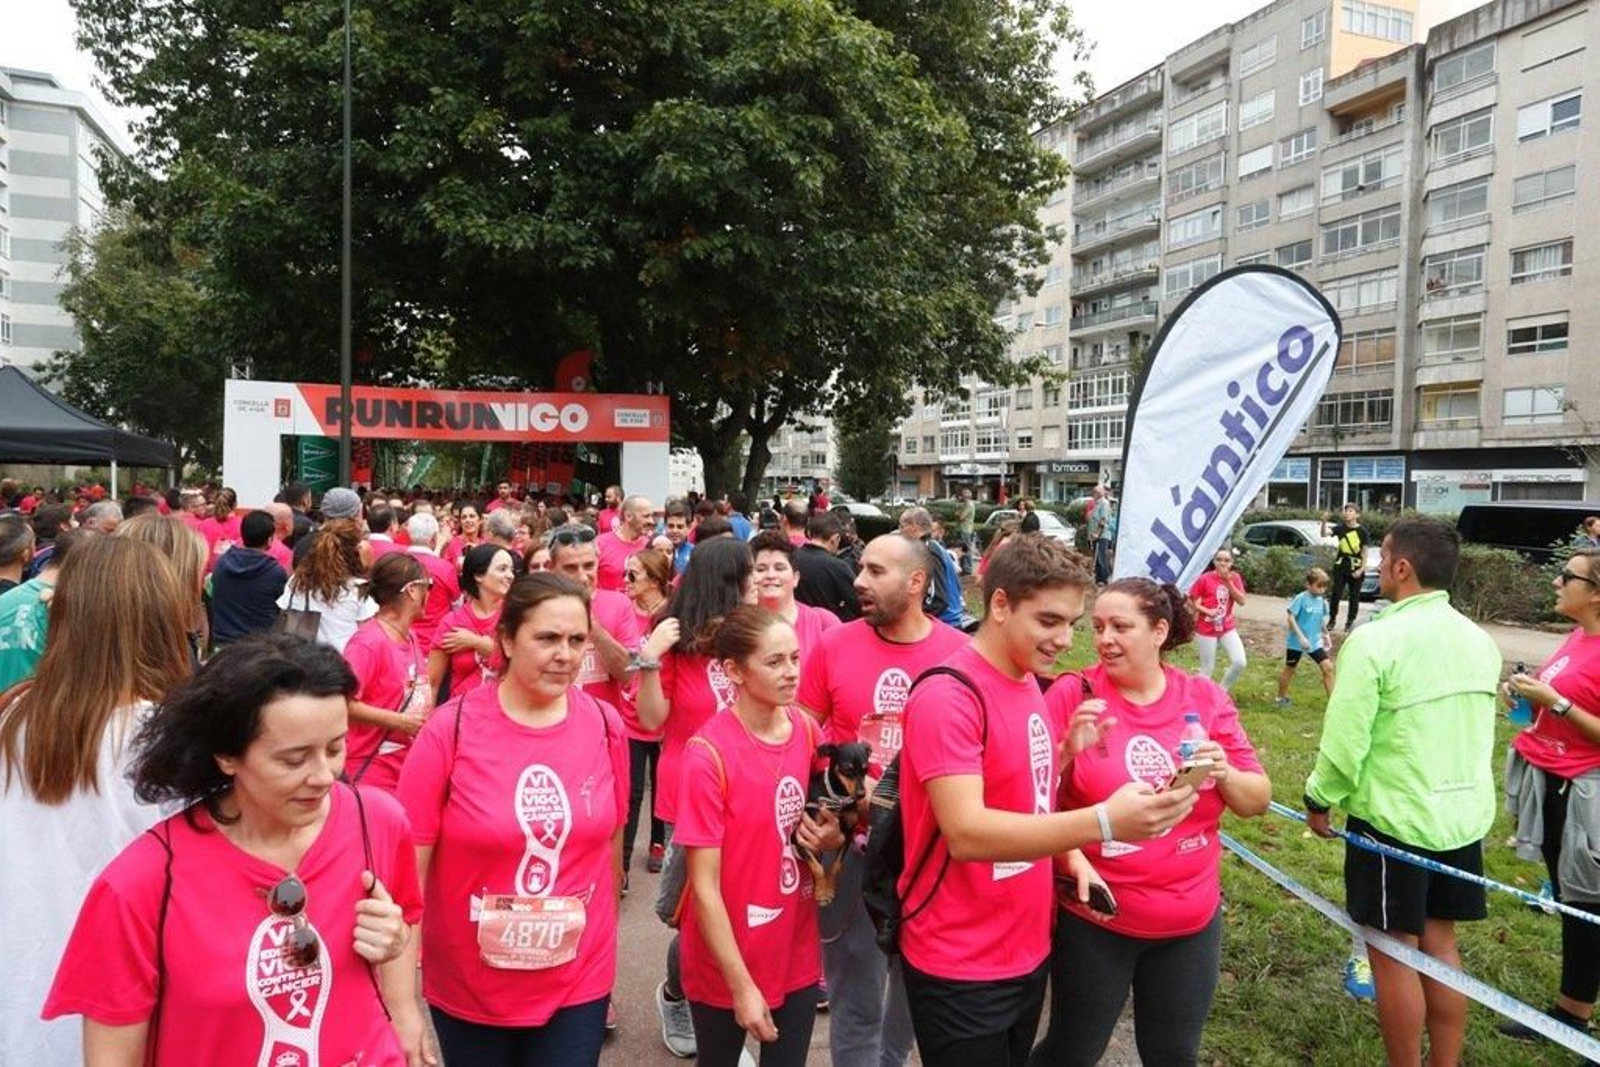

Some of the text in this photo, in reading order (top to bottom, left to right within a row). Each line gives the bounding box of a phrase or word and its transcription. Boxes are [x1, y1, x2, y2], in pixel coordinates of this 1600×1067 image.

[1145, 324, 1314, 585] tlántico
[523, 794, 560, 806] VIGO
[500, 921, 565, 949] 4870
[258, 969, 305, 987] CONTRA
[261, 974, 321, 998] CANCER
